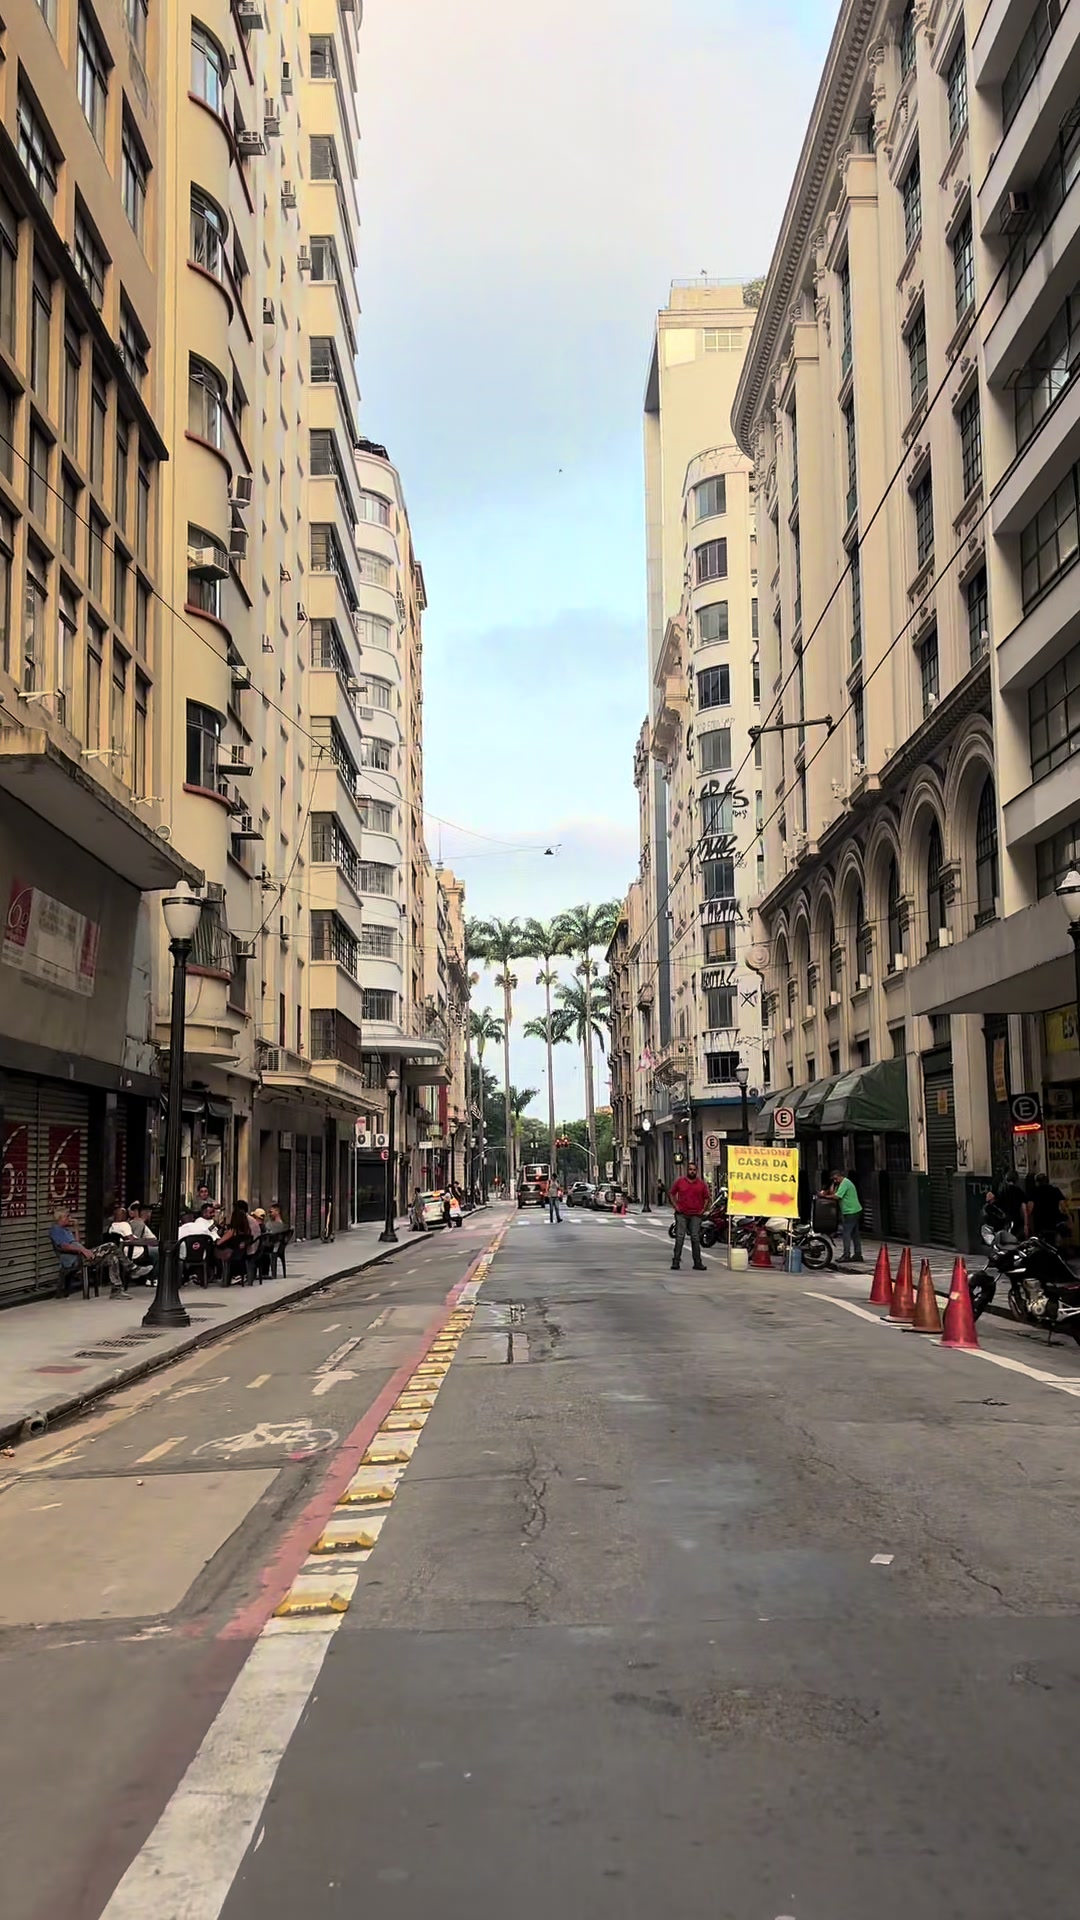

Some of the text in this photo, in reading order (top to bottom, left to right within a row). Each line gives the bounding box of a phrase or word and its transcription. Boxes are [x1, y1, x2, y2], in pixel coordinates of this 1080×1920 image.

[1019, 1101, 1032, 1117] E
[781, 1113, 787, 1123] E
[709, 1138, 715, 1147] E
[1049, 1141, 1072, 1149] RUA
[734, 1147, 792, 1157] ESTACIONE
[738, 1157, 788, 1168] CASA DA
[729, 1171, 797, 1183] FRANCISCA
